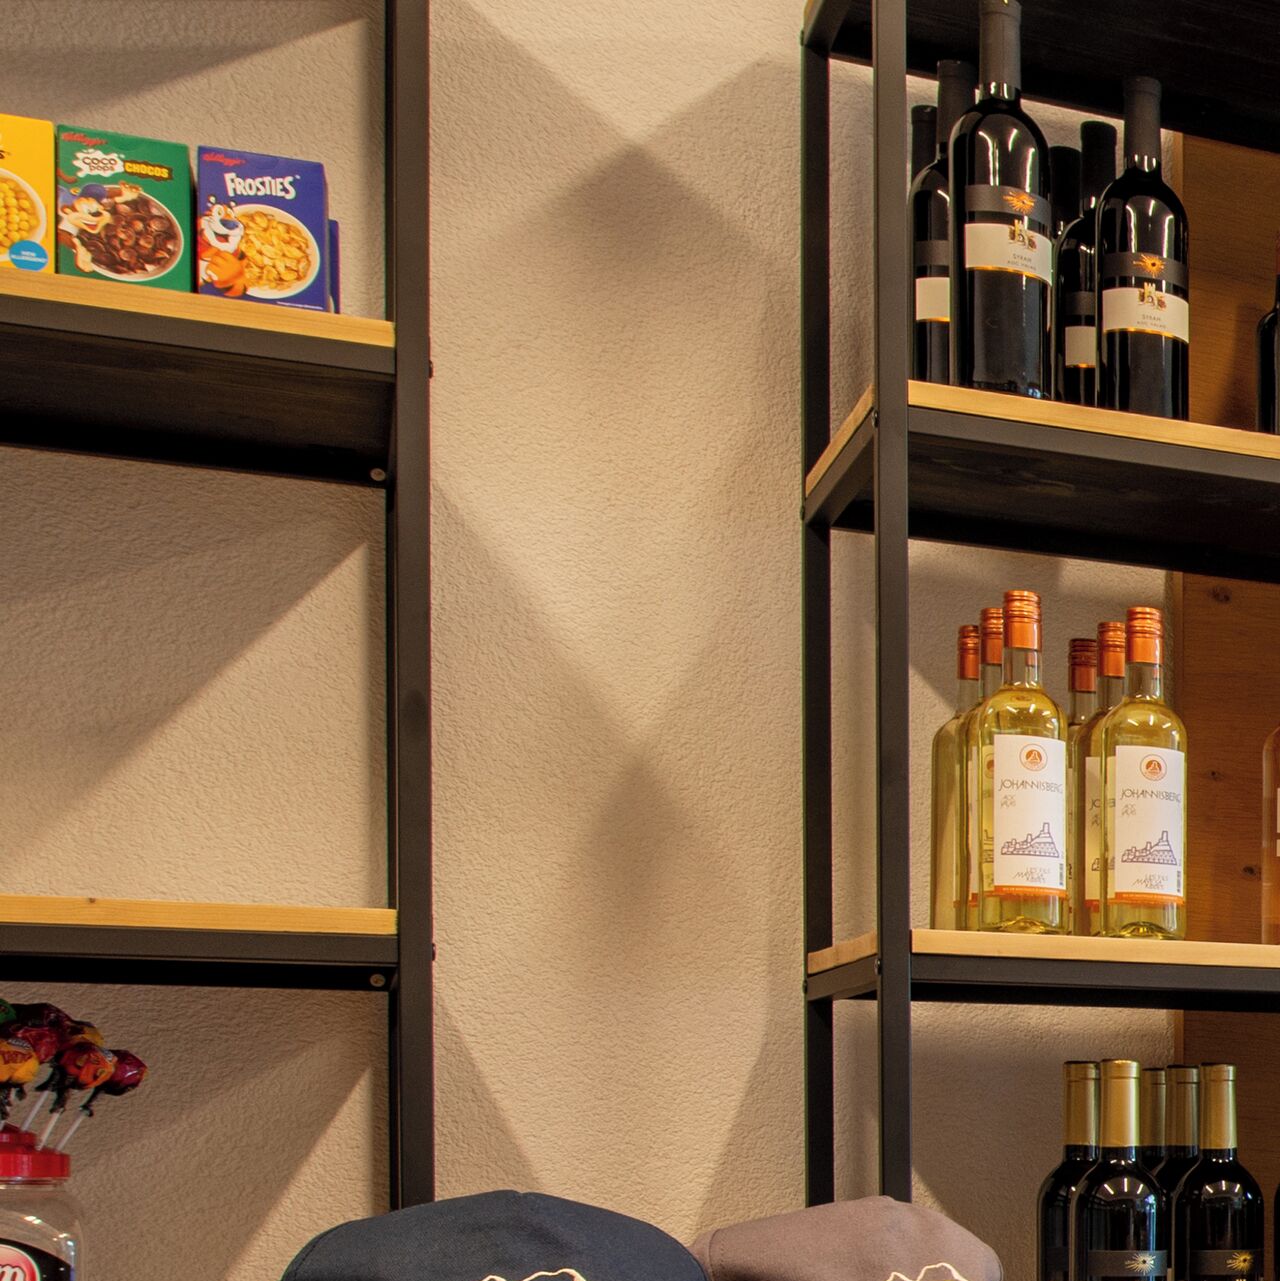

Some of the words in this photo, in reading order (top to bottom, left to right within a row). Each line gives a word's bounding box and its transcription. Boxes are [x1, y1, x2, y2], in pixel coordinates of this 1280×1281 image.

[125, 162, 169, 178] CHOCOS
[224, 172, 296, 199] FROSTIES
[998, 779, 1063, 794] JOHANNISBERG
